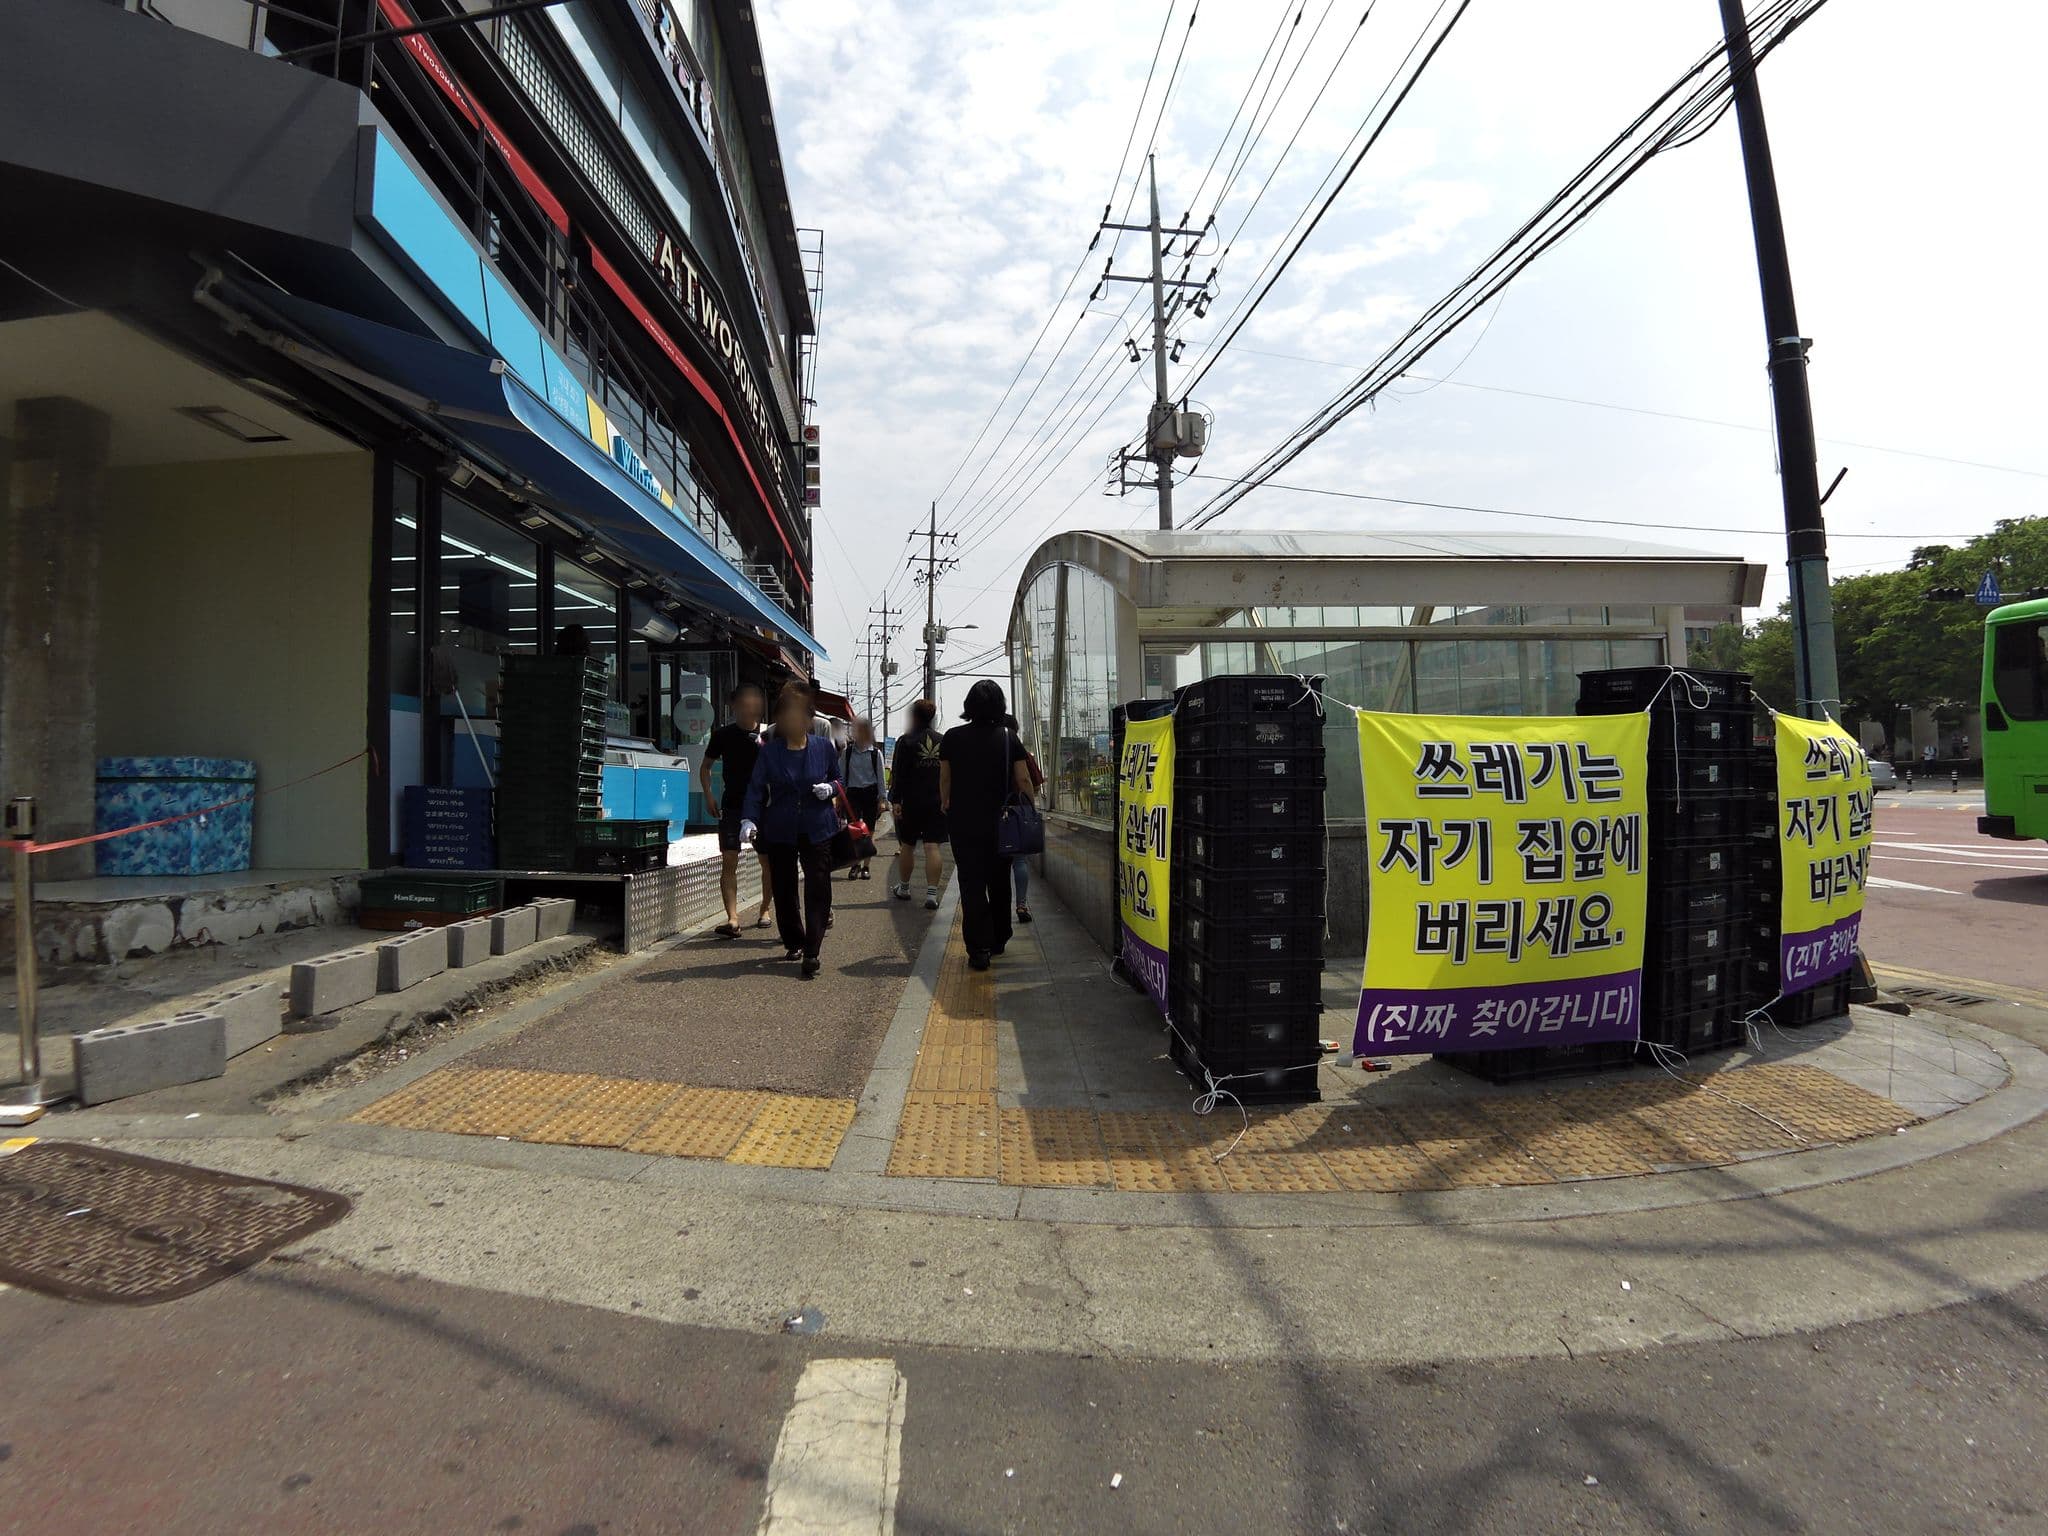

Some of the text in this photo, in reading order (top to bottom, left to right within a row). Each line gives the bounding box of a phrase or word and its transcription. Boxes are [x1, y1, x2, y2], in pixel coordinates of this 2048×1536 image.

[1414, 742, 1624, 803] 쓰레기는
[1377, 813, 1642, 885] 자기 집앞에
[1785, 796, 1841, 848] 자기
[1414, 891, 1625, 965] 버리세요.
[1367, 985, 1634, 1043] (진짜 찾아갑니다)
